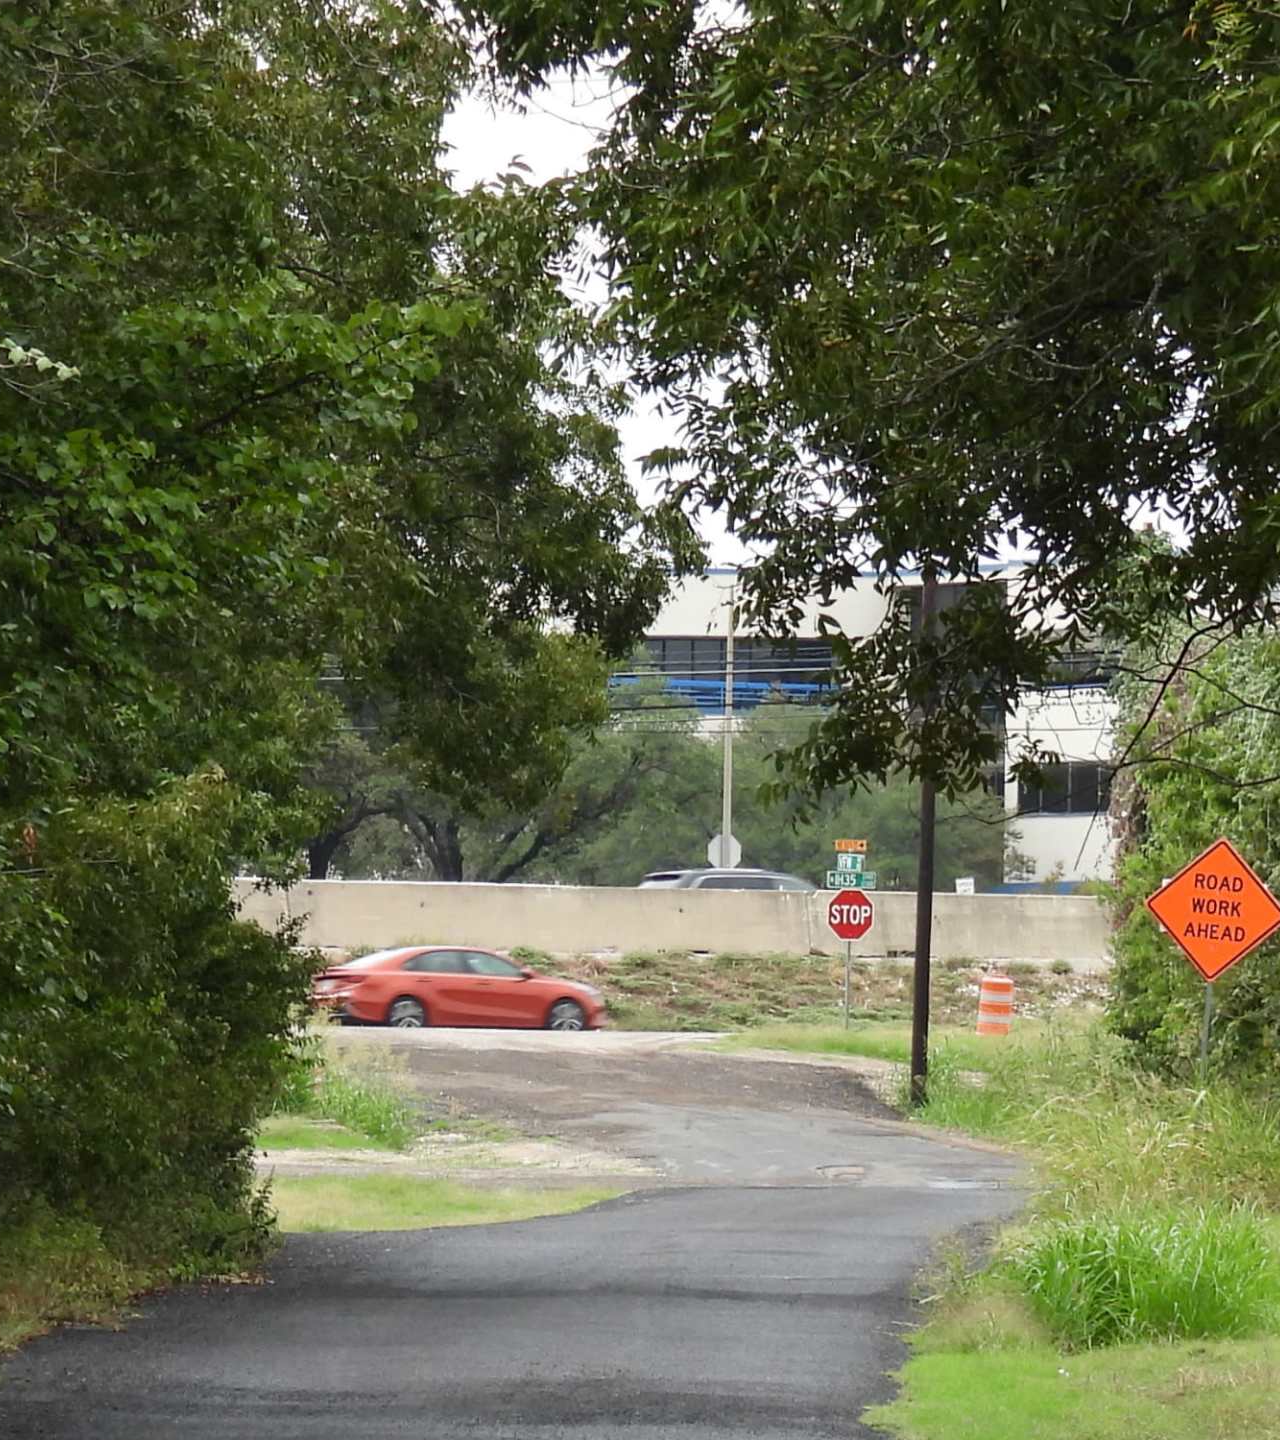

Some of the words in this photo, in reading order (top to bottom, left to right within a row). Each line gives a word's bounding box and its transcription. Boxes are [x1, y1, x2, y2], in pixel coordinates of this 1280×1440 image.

[1195, 873, 1243, 892] ROAD
[831, 905, 870, 925] STOP
[1192, 898, 1241, 917] WORK
[1184, 922, 1245, 942] AHEAD
